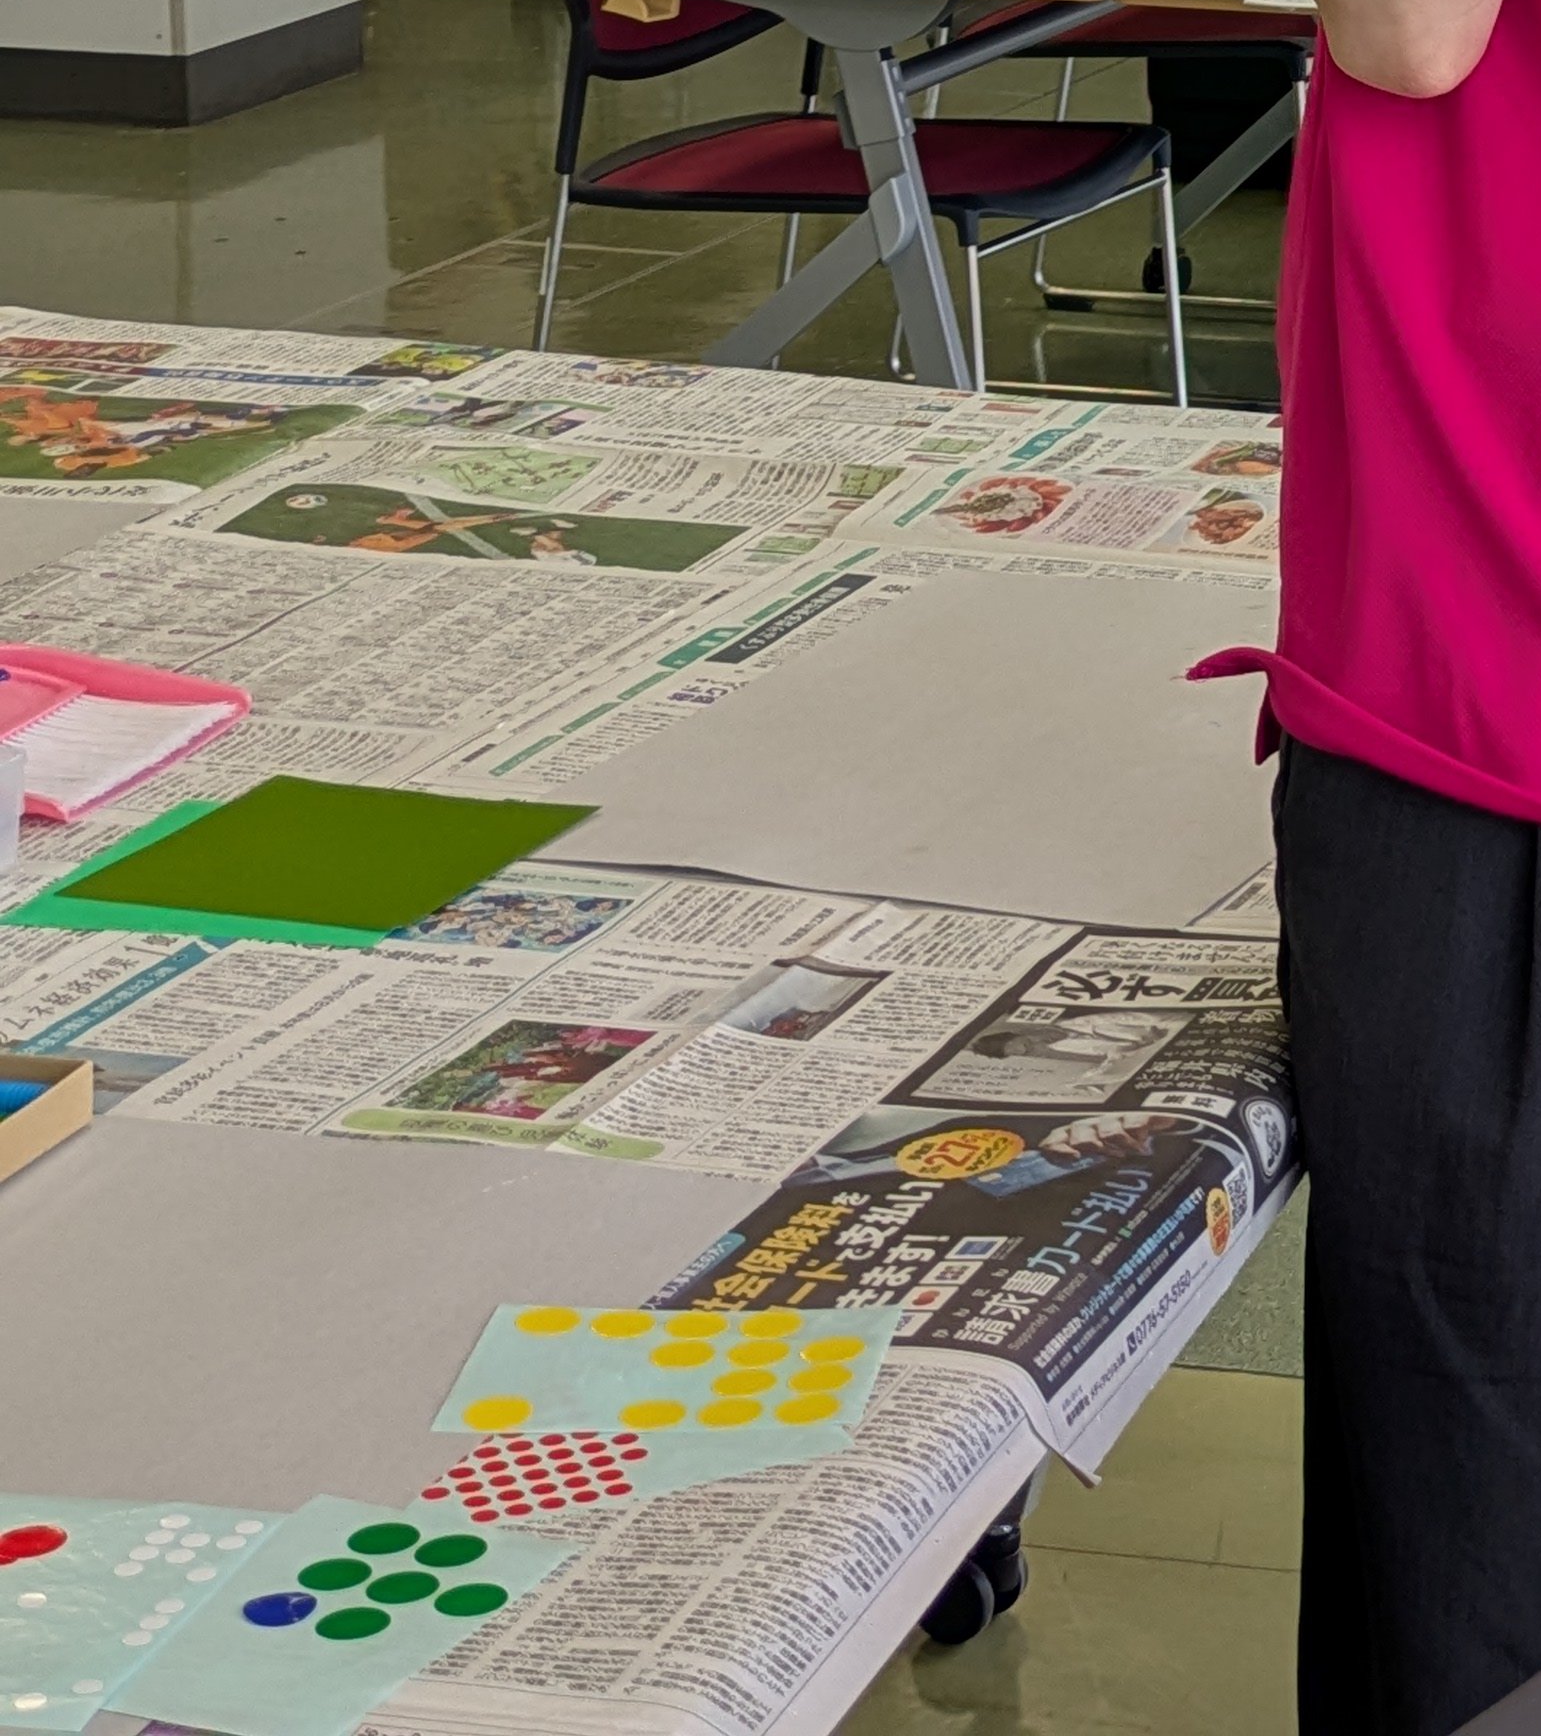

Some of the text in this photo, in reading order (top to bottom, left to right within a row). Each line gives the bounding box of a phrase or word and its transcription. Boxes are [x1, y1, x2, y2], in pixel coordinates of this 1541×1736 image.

[767, 1181, 945, 1311] ードで支払い
[953, 1169, 1153, 1345] 請求書カード払い
